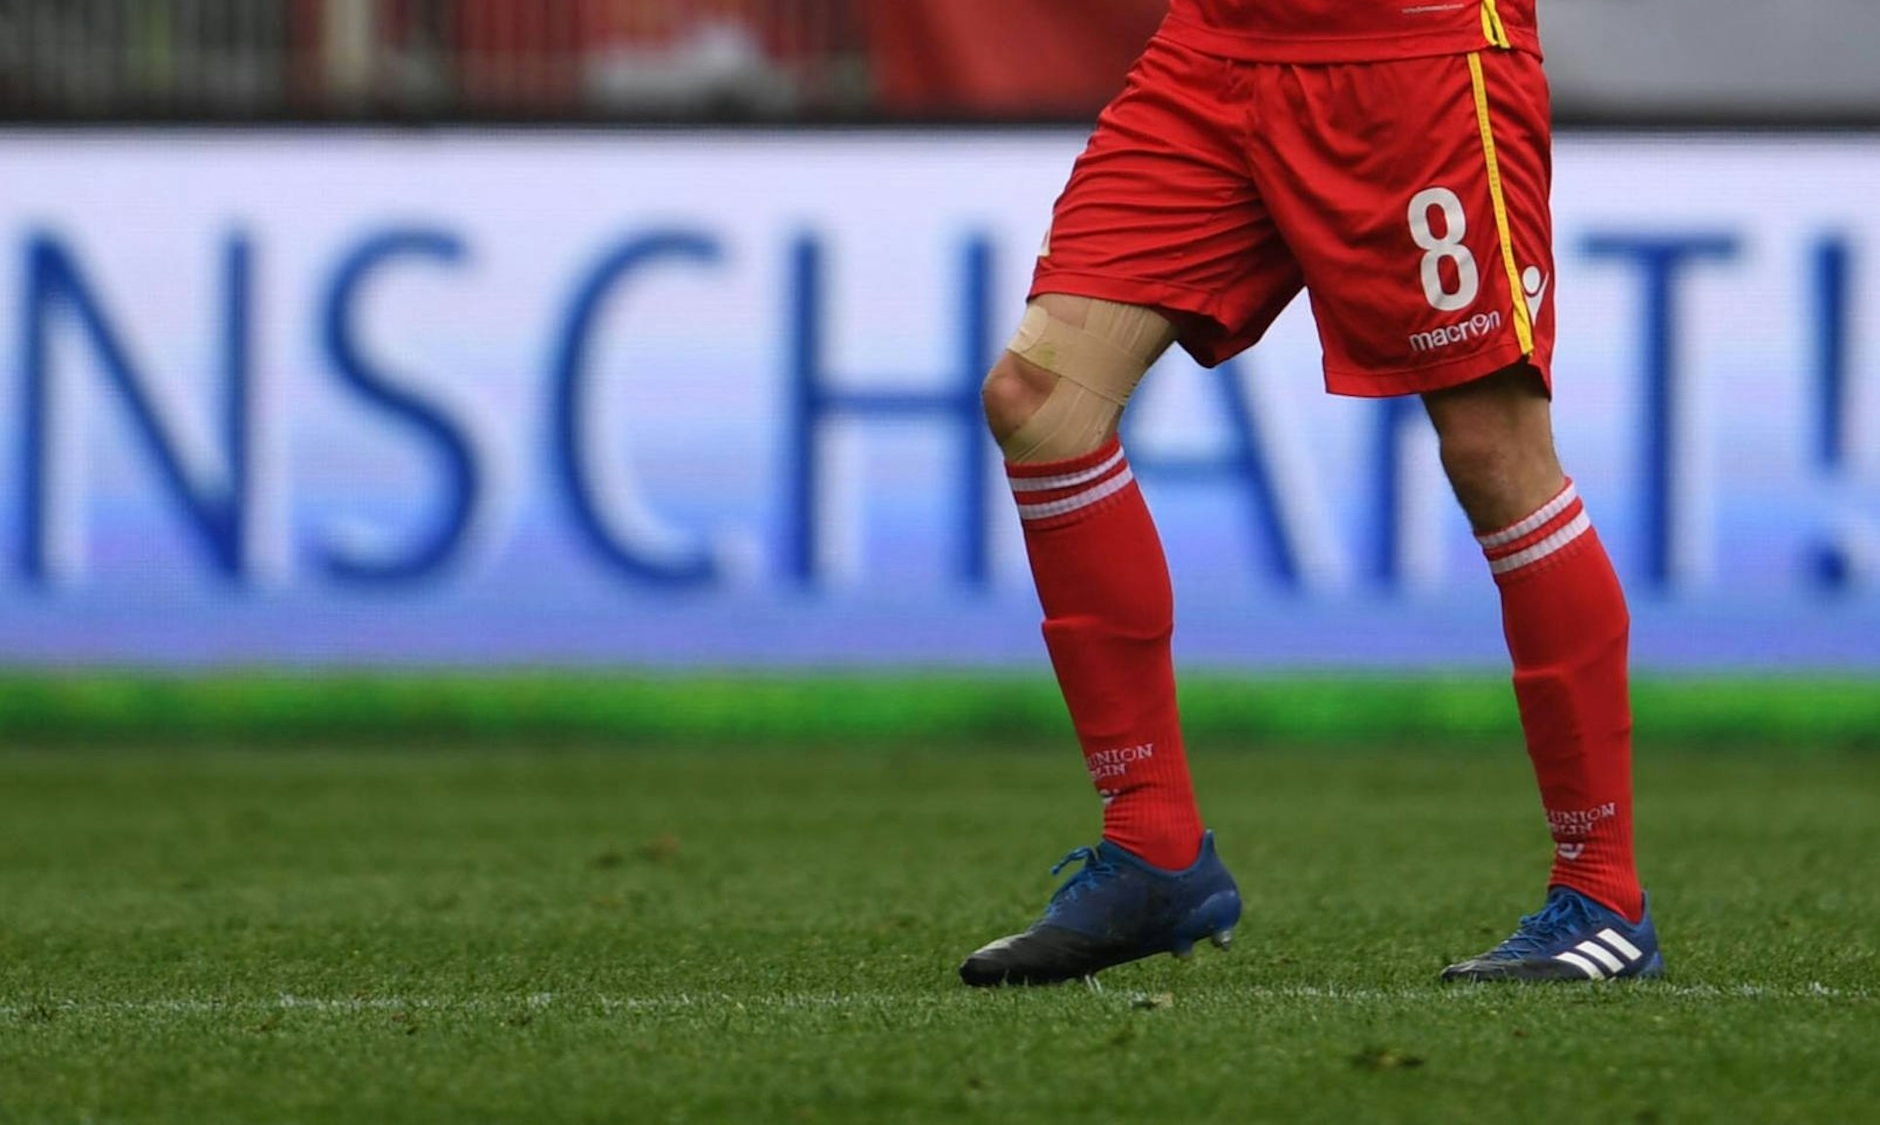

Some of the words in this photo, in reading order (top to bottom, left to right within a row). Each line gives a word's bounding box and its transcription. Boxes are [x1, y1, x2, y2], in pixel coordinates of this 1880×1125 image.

[1407, 187, 1479, 312] 8
[1409, 310, 1501, 352] macron
[20, 226, 1855, 591] NSCHAT!
